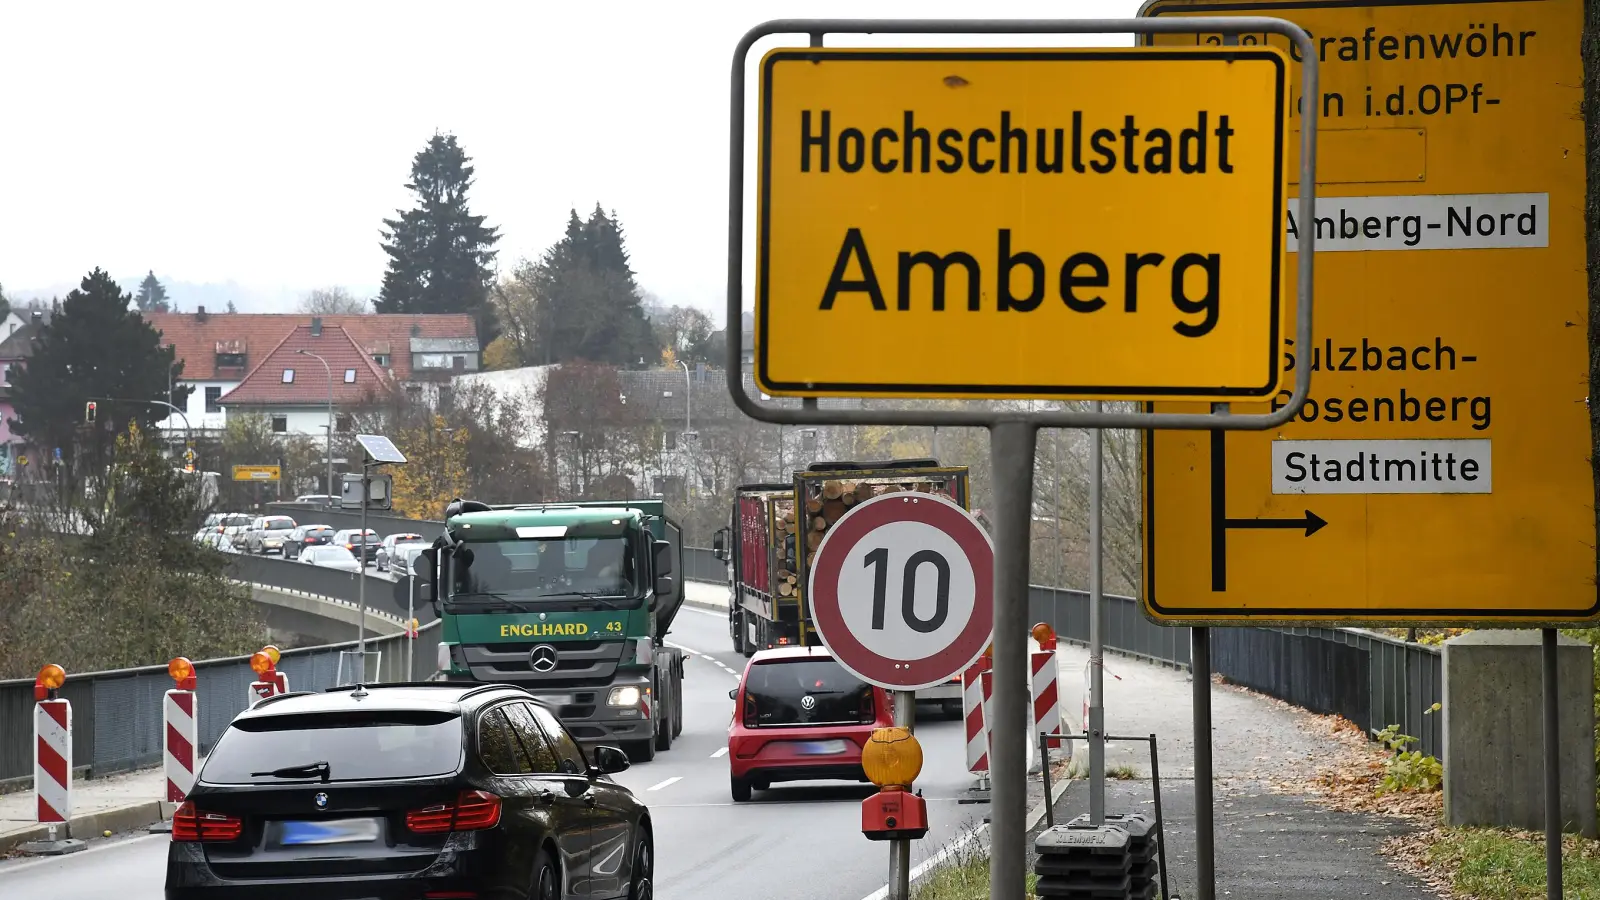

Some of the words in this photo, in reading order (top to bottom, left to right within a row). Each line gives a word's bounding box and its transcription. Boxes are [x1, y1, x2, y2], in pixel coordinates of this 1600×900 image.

[800, 110, 1235, 175] Hochschulstadt
[819, 228, 1221, 337] Amberg
[1285, 451, 1480, 482] Stadtmitte
[863, 547, 951, 634] 10
[500, 623, 589, 638] ENGLHARD
[606, 621, 622, 632] 43
